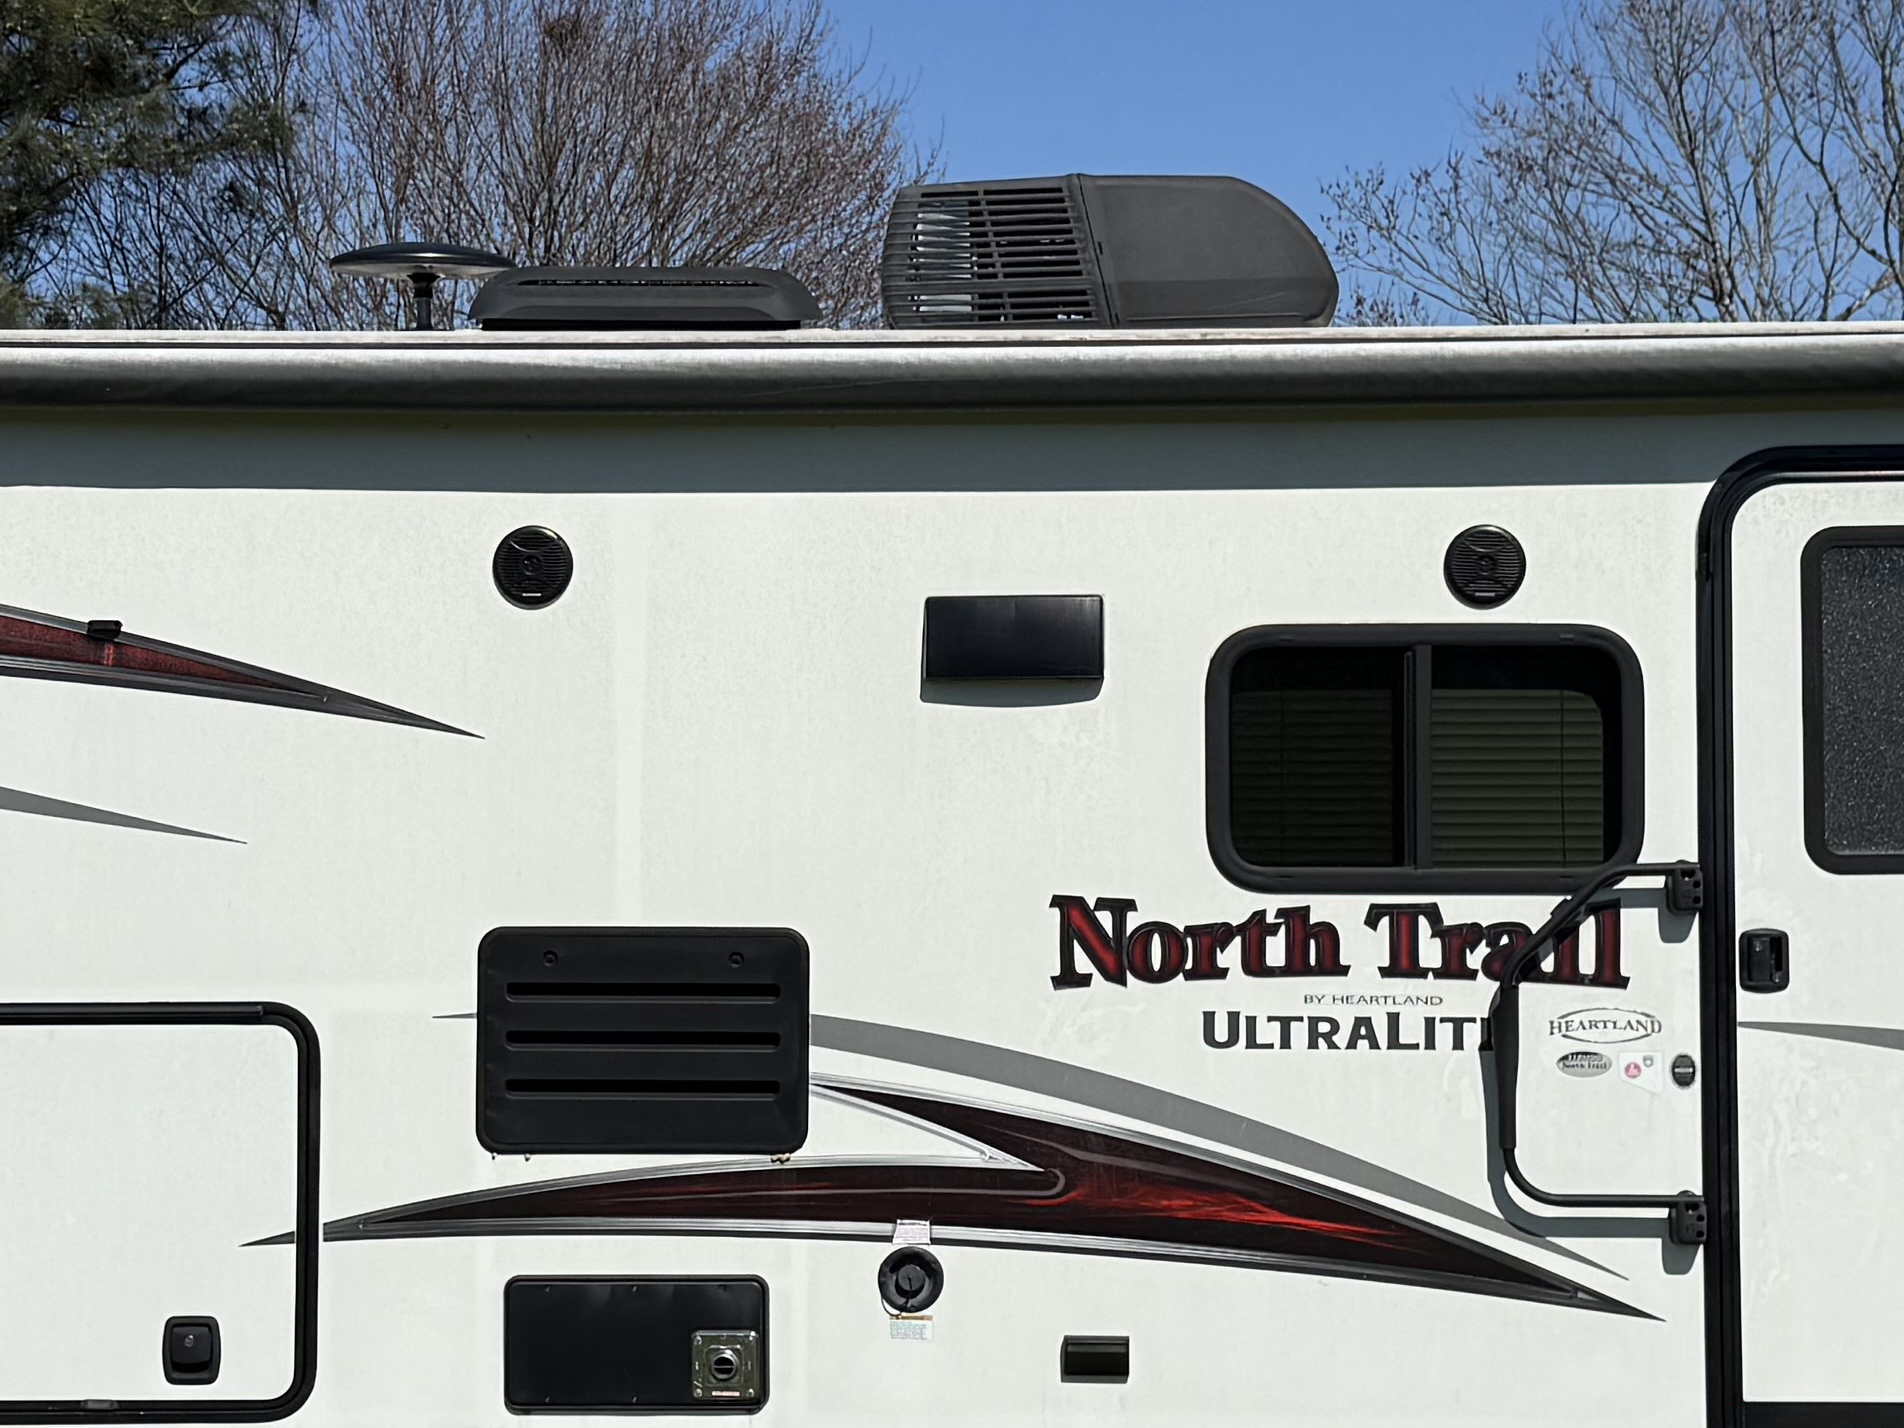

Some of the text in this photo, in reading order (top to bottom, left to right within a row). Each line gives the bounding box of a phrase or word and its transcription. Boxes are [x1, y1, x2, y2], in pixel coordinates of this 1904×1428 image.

[1049, 894, 1351, 990] North
[1304, 994, 1444, 1006] BY HEARTLAND
[1548, 1019, 1662, 1036] HEARTLAND
